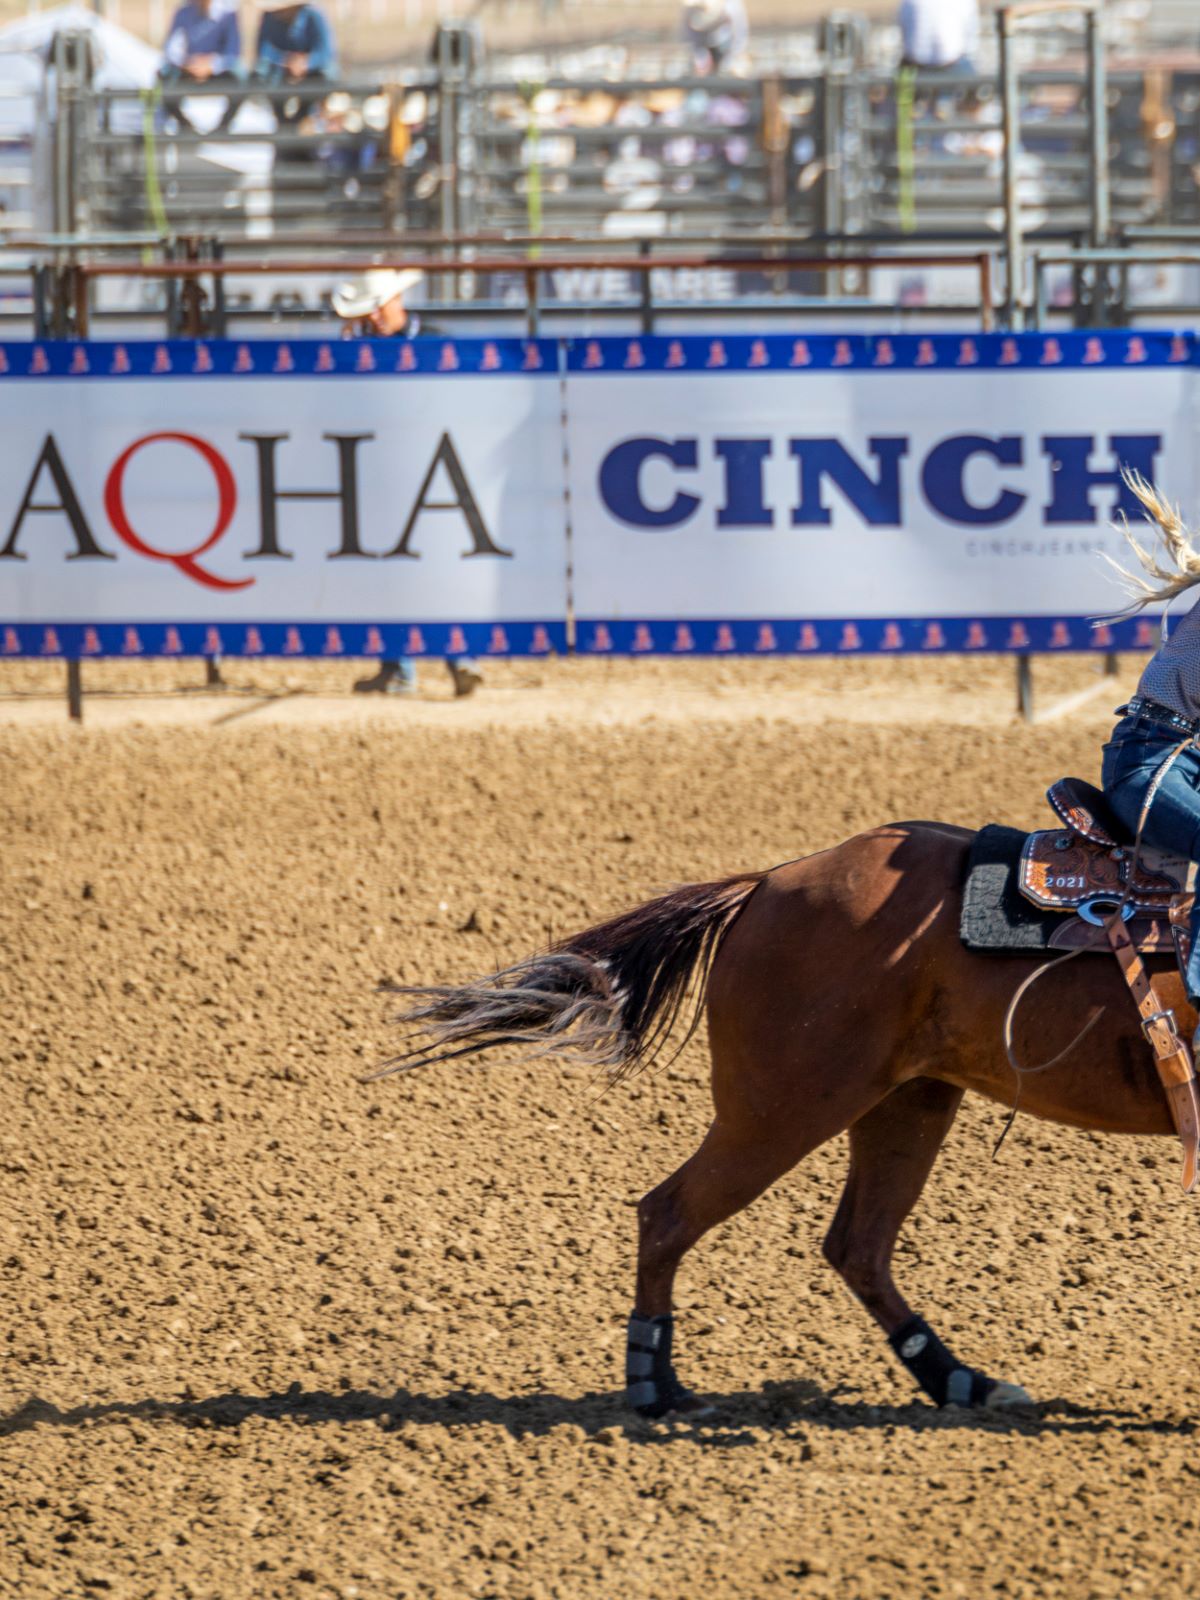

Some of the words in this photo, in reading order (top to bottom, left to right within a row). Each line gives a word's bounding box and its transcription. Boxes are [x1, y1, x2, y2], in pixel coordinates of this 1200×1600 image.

[552, 267, 633, 301] WE
[650, 267, 736, 301] ARE
[0, 431, 515, 592] AQHA
[597, 434, 1164, 530] CINCH
[1044, 875, 1086, 889] 2021
